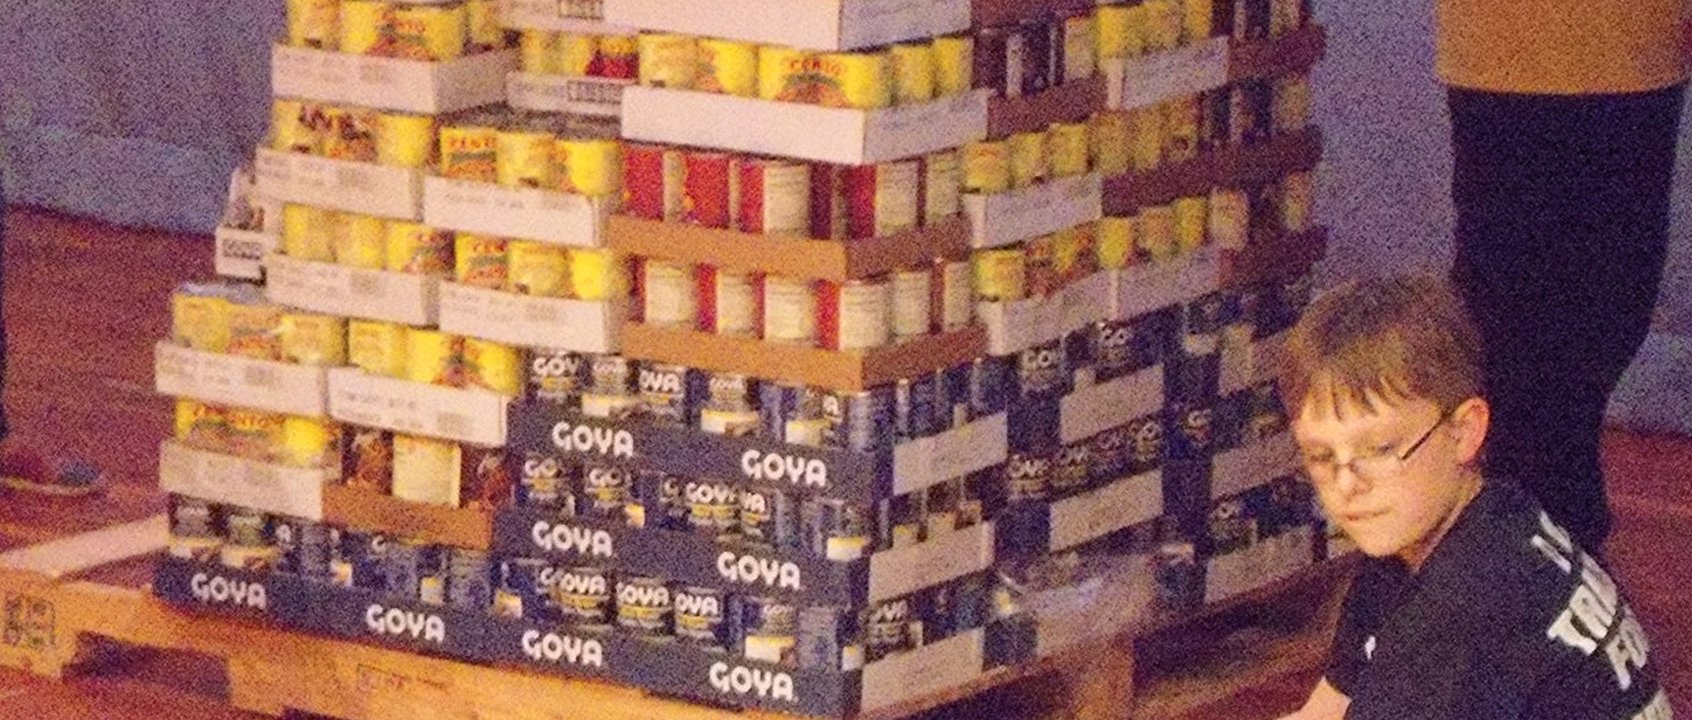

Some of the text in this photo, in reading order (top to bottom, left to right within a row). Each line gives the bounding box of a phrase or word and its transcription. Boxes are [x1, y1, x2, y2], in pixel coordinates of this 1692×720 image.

[552, 421, 634, 458] GOYA
[741, 450, 827, 488] GOYA
[532, 520, 612, 557] GOYA
[716, 551, 800, 590] GOYA
[191, 573, 267, 609] GOYA
[366, 603, 446, 643] GOYA
[522, 629, 603, 667] GOYA
[709, 661, 795, 701] GOYA
